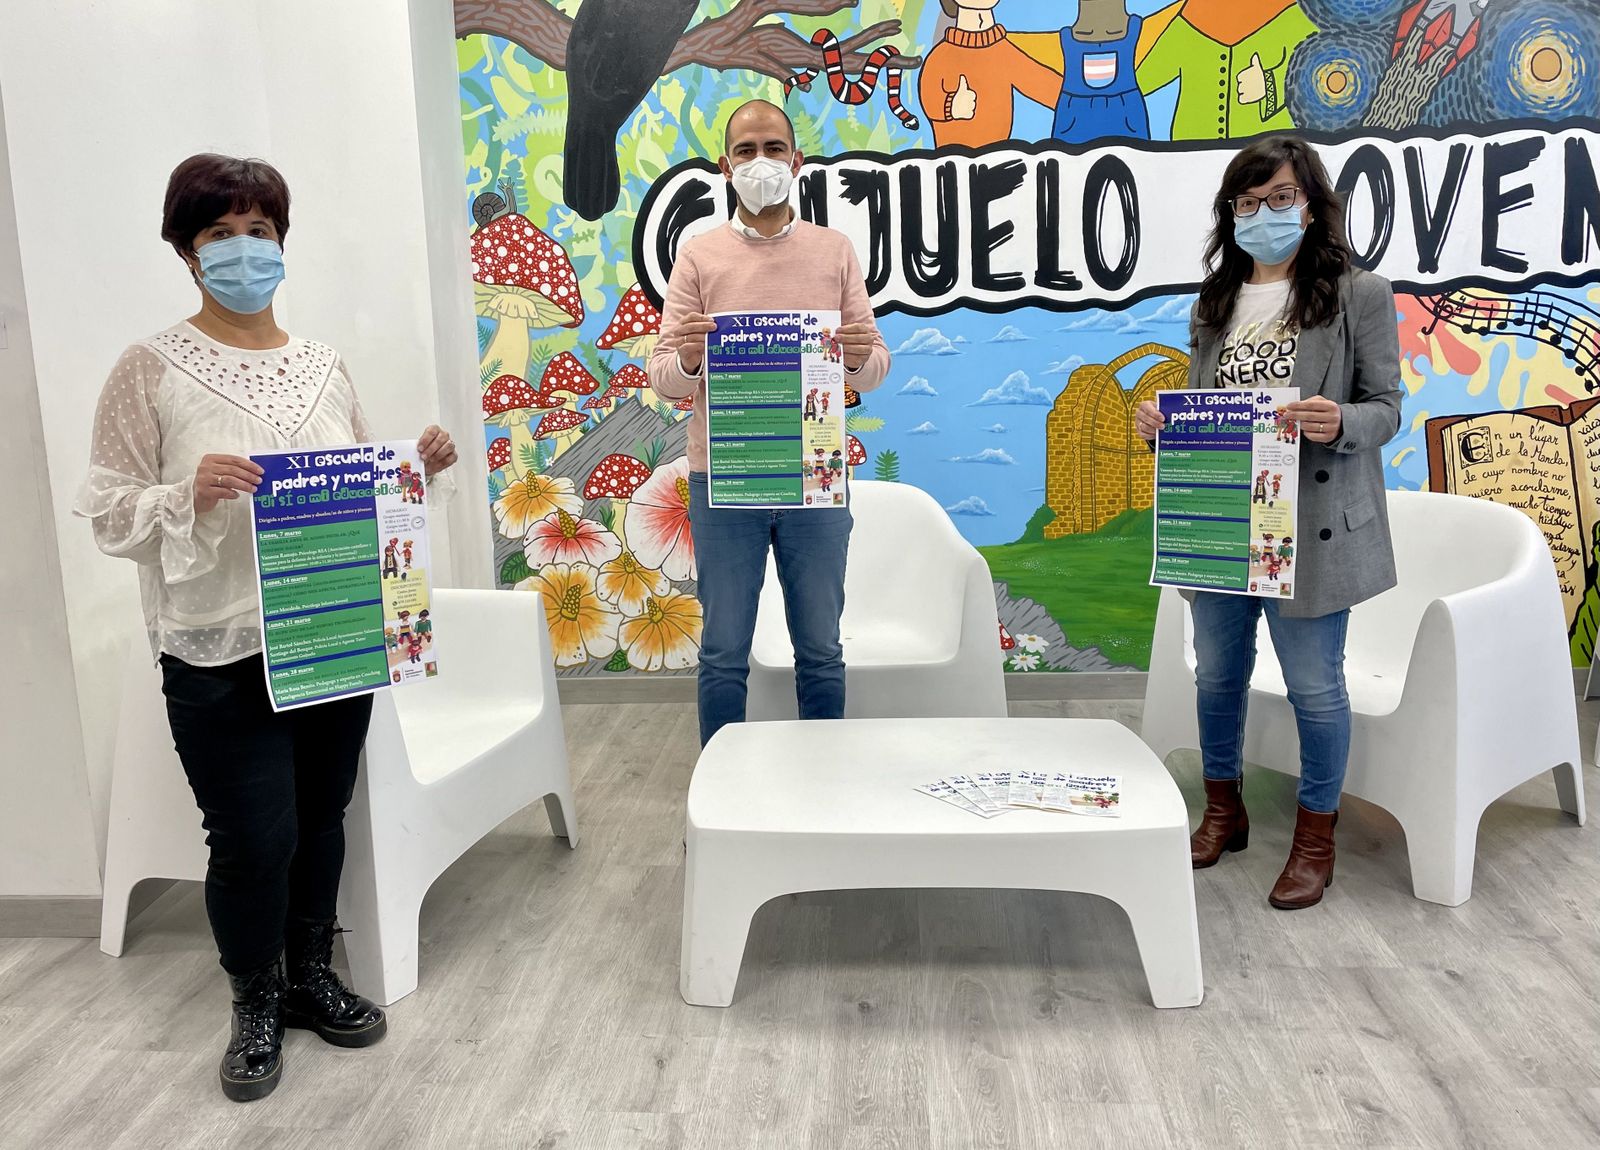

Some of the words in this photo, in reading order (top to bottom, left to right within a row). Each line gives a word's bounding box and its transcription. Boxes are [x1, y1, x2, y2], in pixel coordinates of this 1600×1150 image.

[732, 316, 750, 327] XI
[754, 313, 800, 326] escuela
[804, 313, 818, 326] de
[720, 330, 763, 347] padres
[766, 334, 774, 346] y
[776, 329, 824, 342] madres
[1218, 338, 1296, 367] GOOD
[1217, 356, 1294, 388] NERG
[1184, 395, 1201, 406] XI
[1205, 392, 1253, 405] escuela
[1256, 391, 1272, 404] de
[1171, 408, 1214, 425] padres
[1217, 412, 1224, 425] y
[1228, 407, 1278, 420] madres
[1509, 431, 1522, 439] un
[286, 455, 310, 470] XI
[315, 447, 374, 467] escuela
[377, 446, 395, 461] de
[1496, 443, 1510, 458] de
[1519, 441, 1528, 456] la
[272, 472, 327, 496] padres
[330, 475, 340, 491] y
[344, 466, 401, 484] madres
[1464, 470, 1477, 484] de
[1482, 469, 1505, 484] cuyo
[1512, 462, 1549, 478] nombre
[297, 495, 305, 504] a
[1509, 495, 1539, 509] mucho
